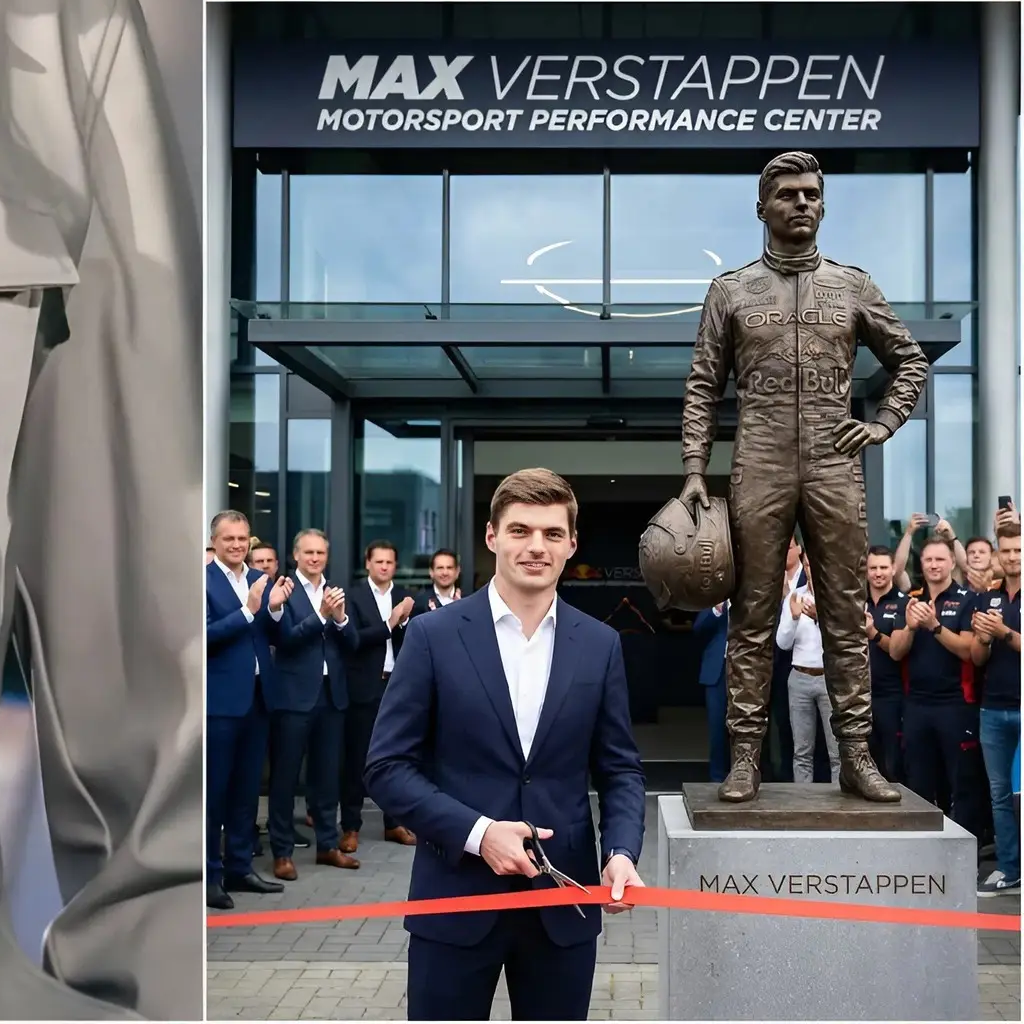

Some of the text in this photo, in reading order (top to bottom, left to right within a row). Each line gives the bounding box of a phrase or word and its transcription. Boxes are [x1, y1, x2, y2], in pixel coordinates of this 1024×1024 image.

[317, 55, 885, 100] MAX VERSTAPPEN
[316, 108, 882, 131] MOTORSPORT PERFORMANCE CENTER
[745, 308, 847, 328] ORACLE
[749, 367, 797, 393] Red
[699, 874, 945, 895] MAX VERSTAPPEN
